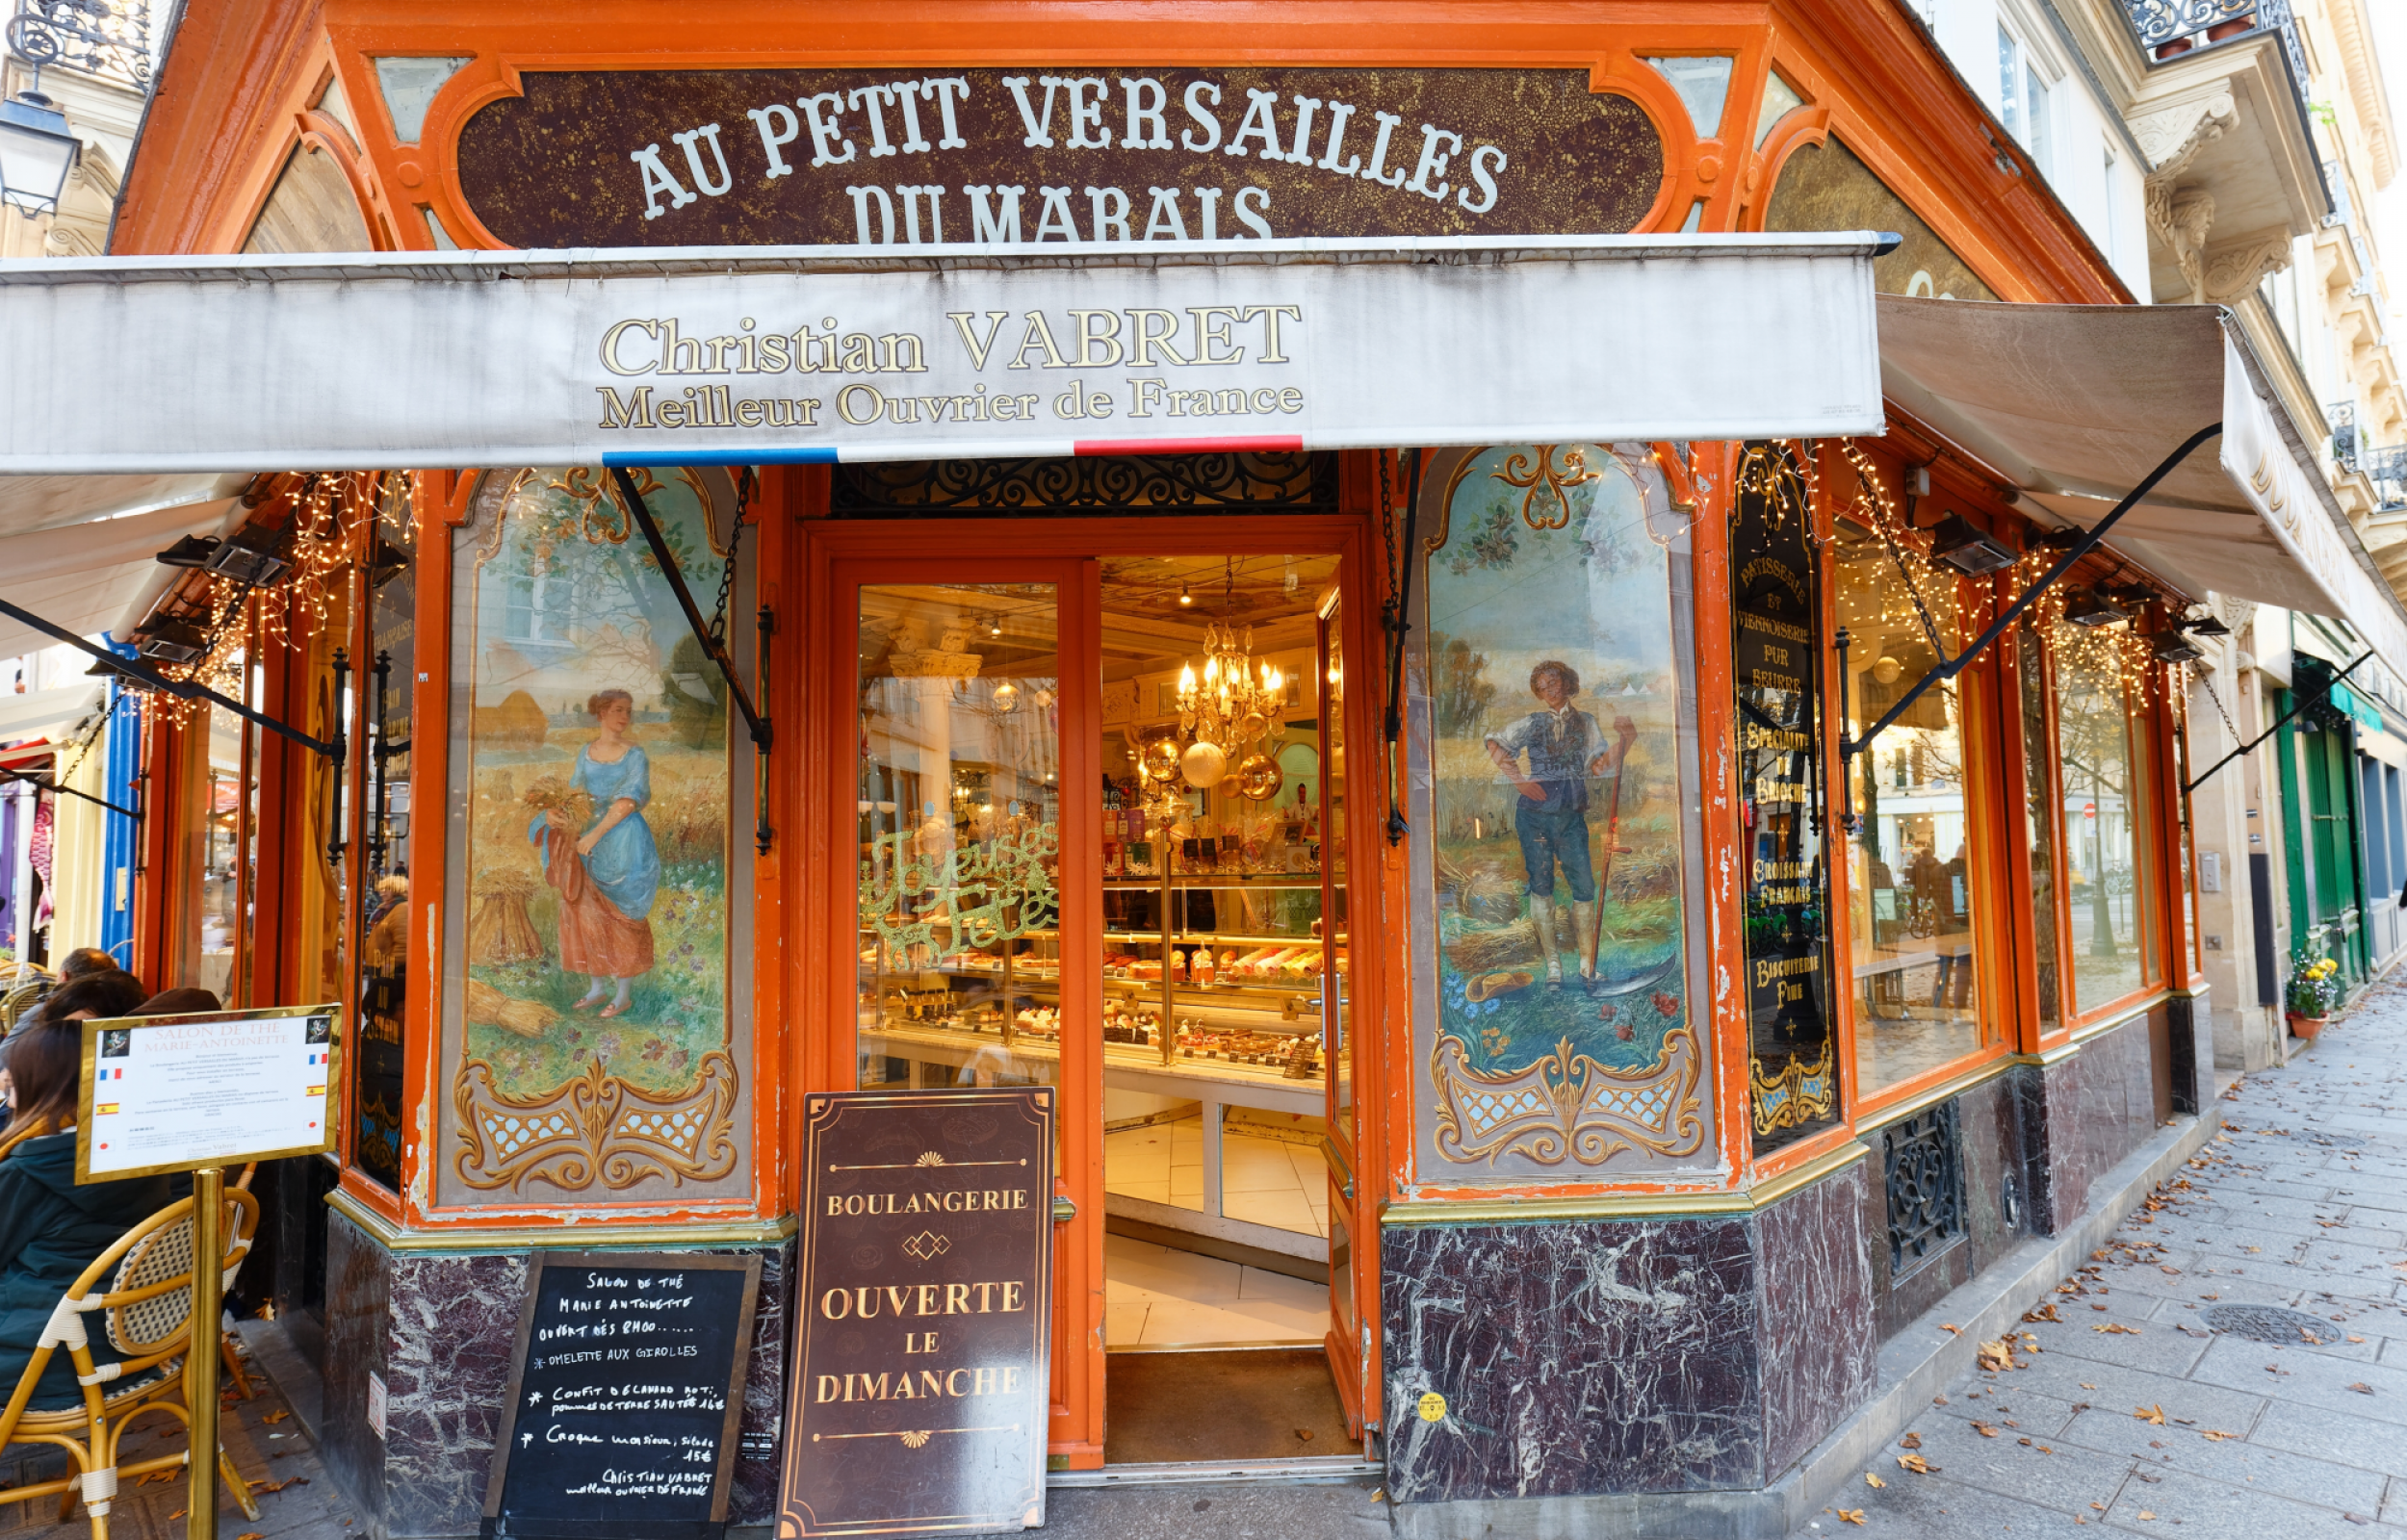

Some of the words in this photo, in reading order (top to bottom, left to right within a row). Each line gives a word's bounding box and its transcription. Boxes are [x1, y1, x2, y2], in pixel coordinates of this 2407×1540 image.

[630, 122, 734, 220] AU
[746, 76, 970, 179] PETIT
[1002, 74, 1508, 216] VERSAILLES
[846, 185, 945, 244] DU
[963, 184, 1273, 244] MARAIS
[599, 317, 928, 376] Christian
[946, 302, 1304, 372] VABRET
[596, 383, 820, 432] Meilleur
[836, 378, 1038, 426] Ouvrier
[1053, 379, 1112, 421] de
[1126, 377, 1304, 418] France
[1740, 556, 1806, 605] PATISSERIE
[1767, 592, 1782, 611] ET
[1737, 610, 1811, 644] VIENNOISERIE
[1764, 644, 1789, 668] PUR
[1752, 668, 1801, 694] BEURRE
[1755, 777, 1806, 805] BRIOCHE
[1752, 858, 1813, 884] CROISSANT
[1756, 956, 1819, 988] BISCUITERIE
[1776, 980, 1803, 1011] FINE
[144, 1035, 289, 1053] MARIE-ANTOINETTE
[155, 1026, 214, 1040] SALON
[220, 1024, 242, 1036] DE
[826, 1189, 1029, 1217] BOULANGERIE
[637, 1278, 652, 1290] DE
[820, 1280, 1026, 1321] OUVERTE
[548, 1350, 603, 1367] OMELETTE
[607, 1348, 631, 1362] AUX
[635, 1346, 698, 1359] GIROLLES
[904, 1331, 940, 1354] LE
[814, 1366, 1022, 1404] DIMANCHE
[682, 1449, 712, 1463] 15€
